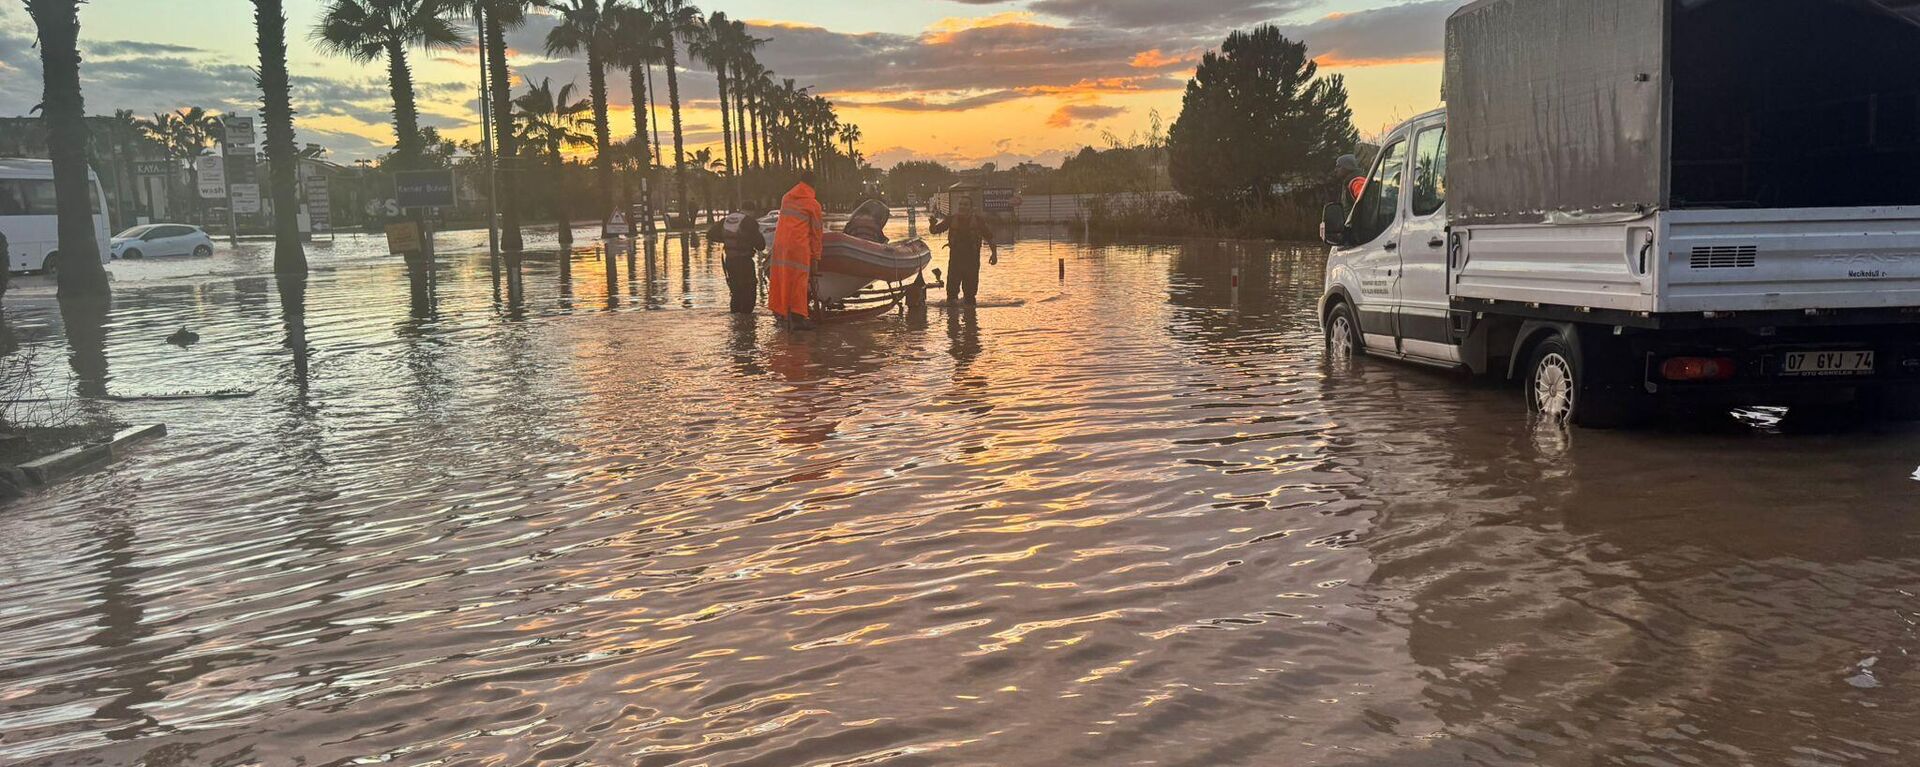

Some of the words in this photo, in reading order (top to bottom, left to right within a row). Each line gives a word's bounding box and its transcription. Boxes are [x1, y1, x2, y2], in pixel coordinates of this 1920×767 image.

[138, 163, 160, 174] KAYA
[201, 186, 224, 195] wash
[1788, 354, 1805, 370] 07
[1816, 353, 1843, 369] GYJ
[1855, 352, 1872, 369] 74
